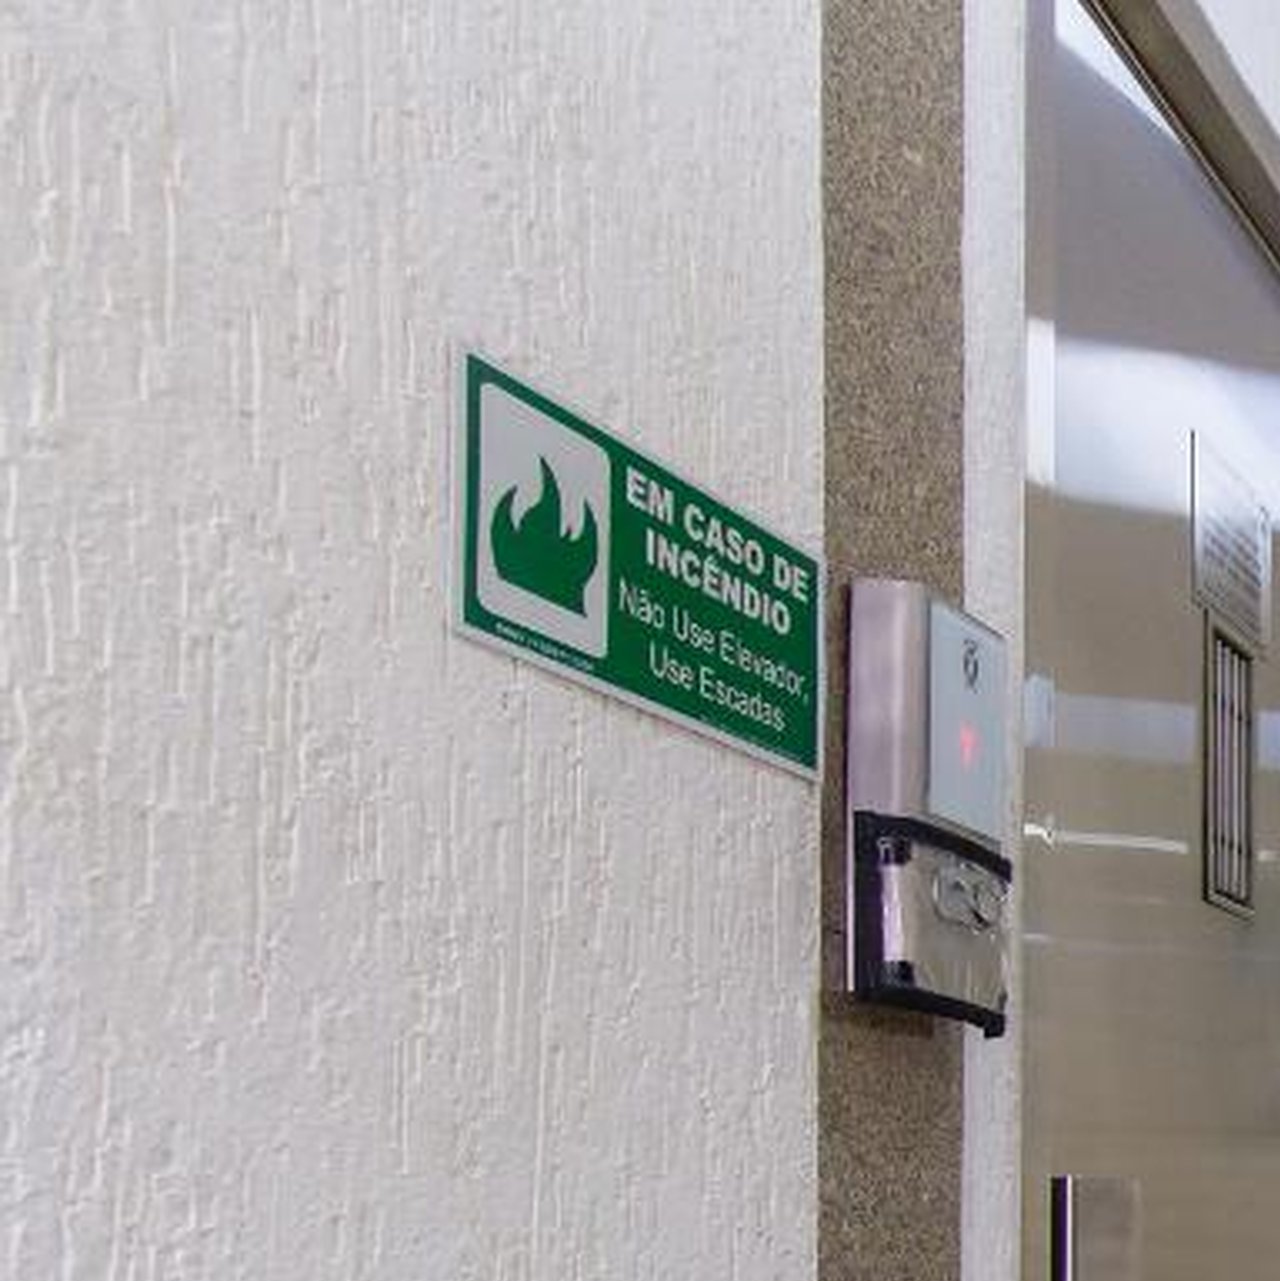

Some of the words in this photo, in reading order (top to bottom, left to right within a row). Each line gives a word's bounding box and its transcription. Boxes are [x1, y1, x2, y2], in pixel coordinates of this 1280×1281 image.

[626, 466, 674, 526] EM
[684, 503, 765, 576] CASO
[773, 553, 809, 602] DE
[646, 528, 792, 635] INCÊNDIO
[619, 576, 665, 629] Não
[673, 605, 715, 651] Use
[650, 640, 694, 690] Use
[700, 665, 786, 732] Escadas
